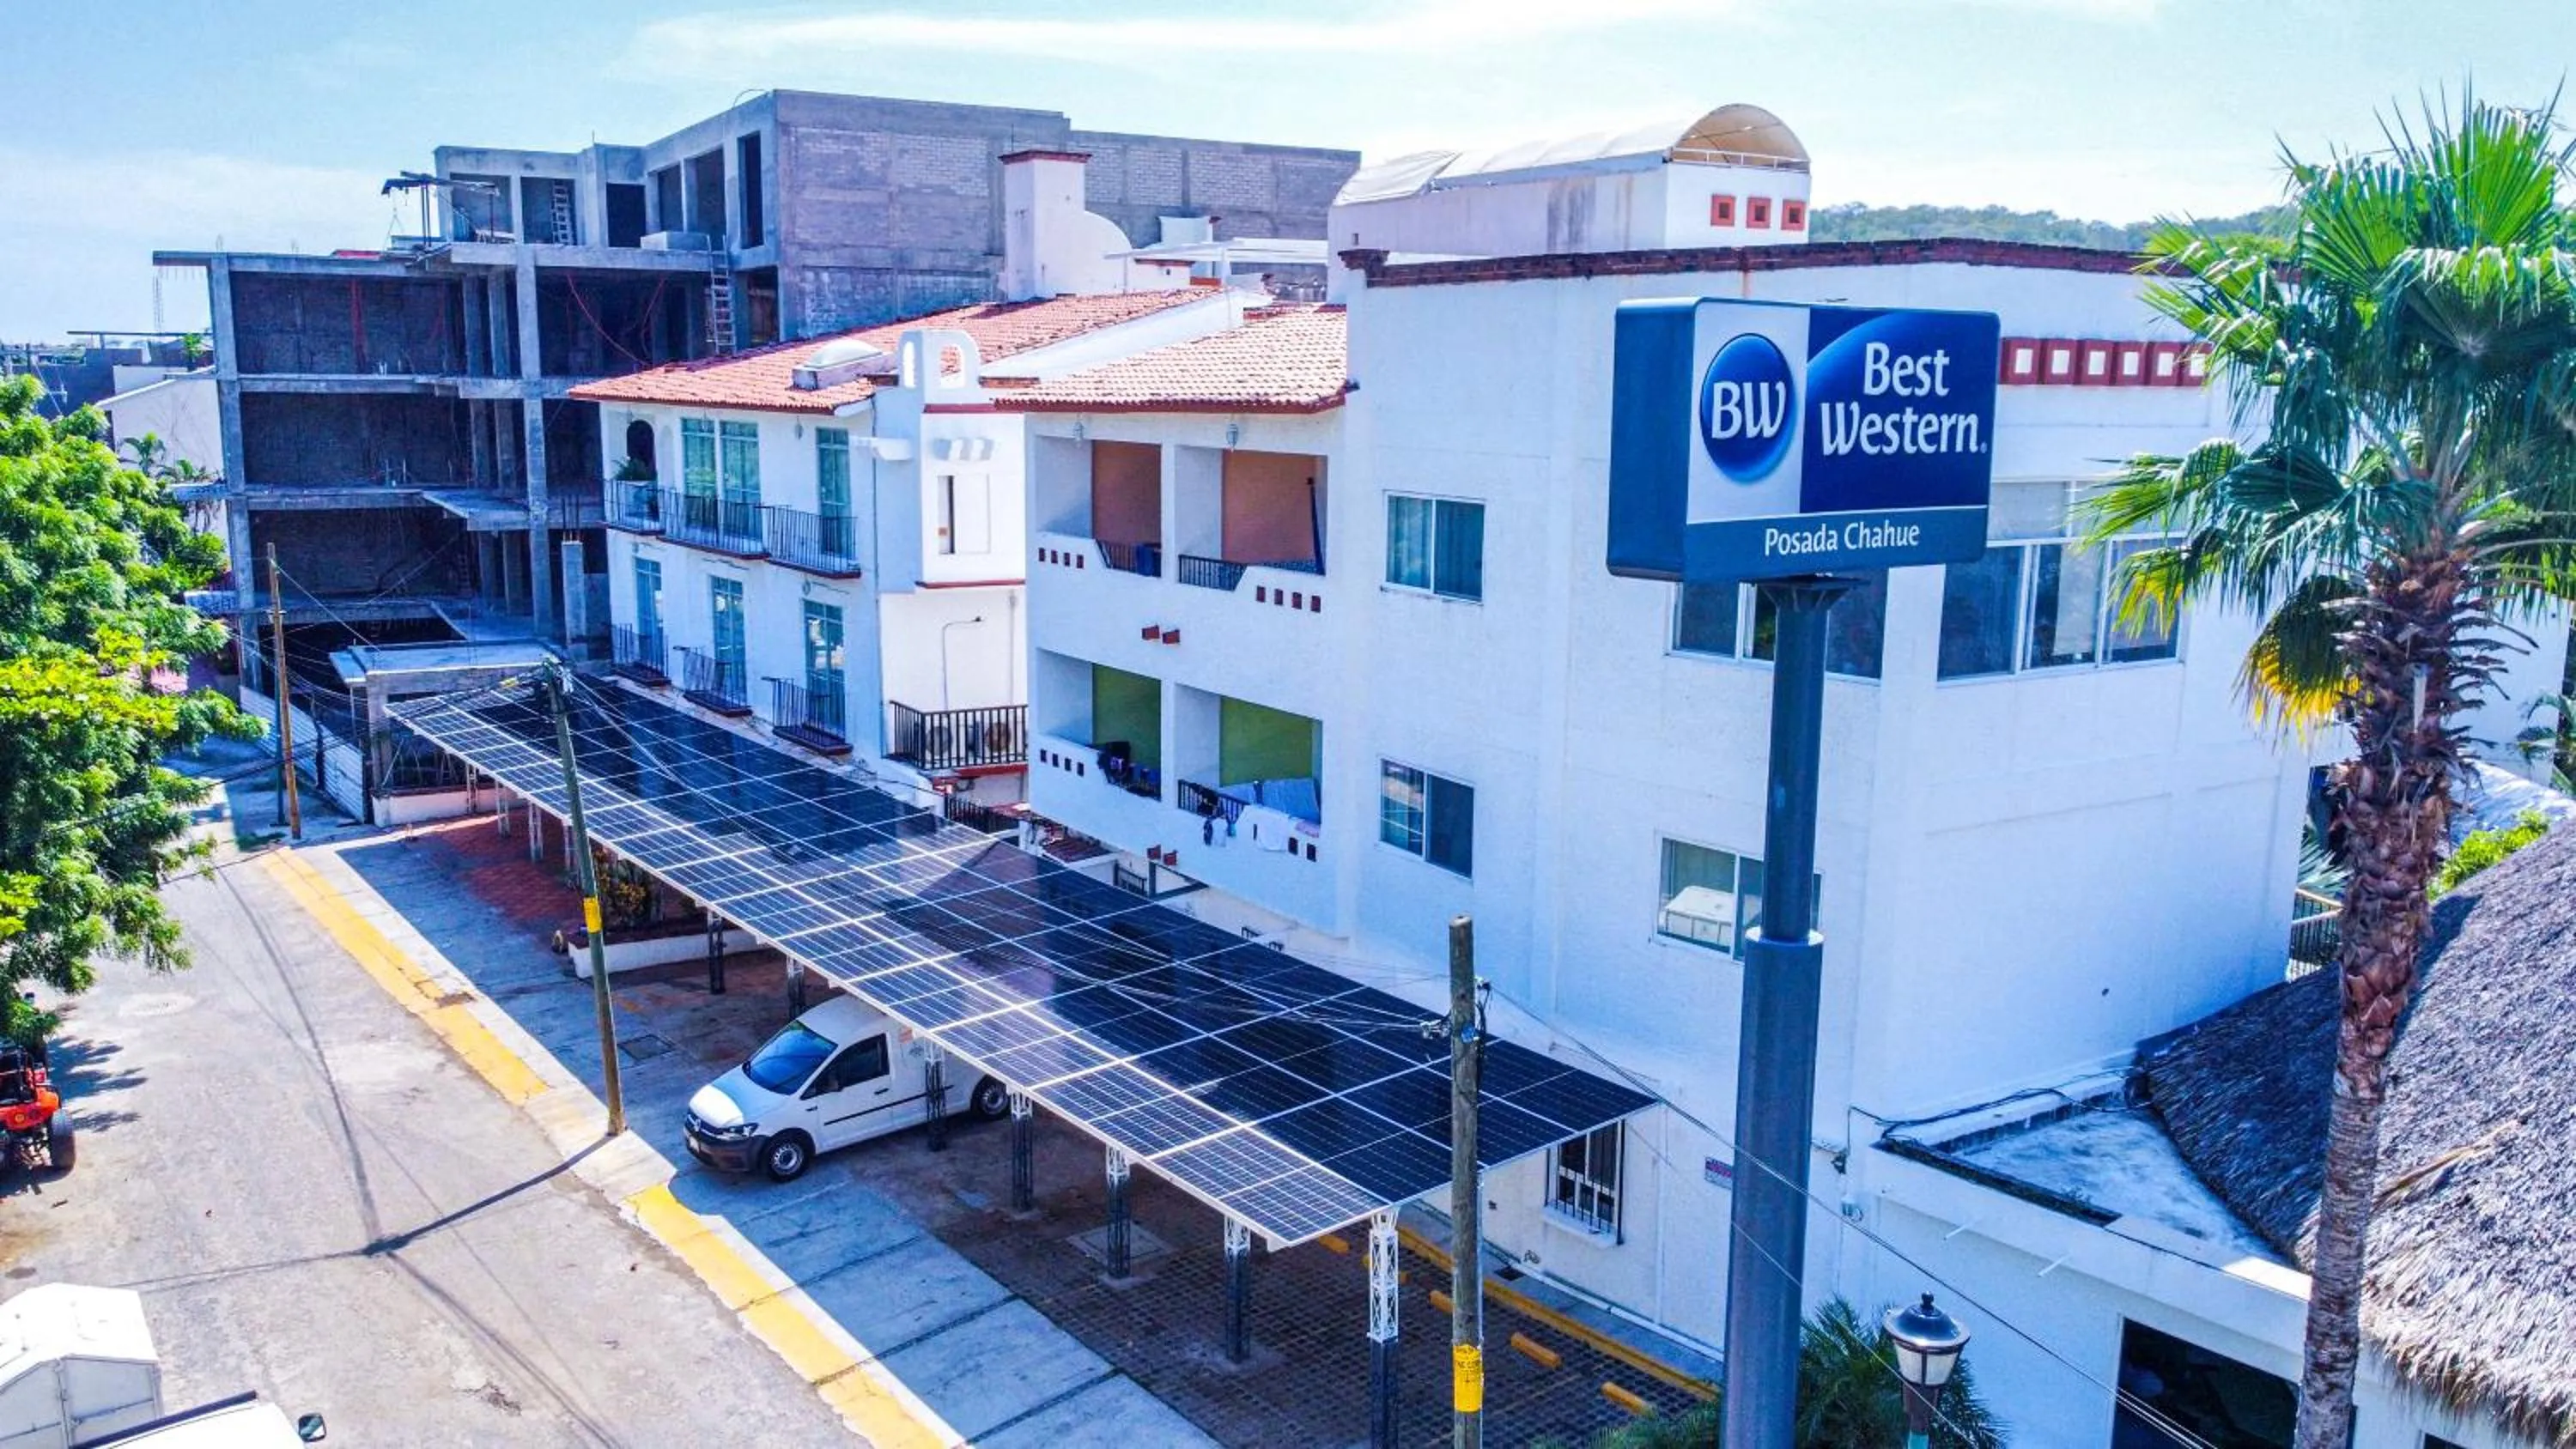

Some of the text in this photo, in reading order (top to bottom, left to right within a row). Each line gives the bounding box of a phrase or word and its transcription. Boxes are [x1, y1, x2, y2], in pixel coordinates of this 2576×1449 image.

[1863, 341, 1950, 397] Best
[1710, 380, 1787, 440] BW
[1820, 401, 1979, 457] Western
[1765, 519, 1921, 556] Posada Chahue
